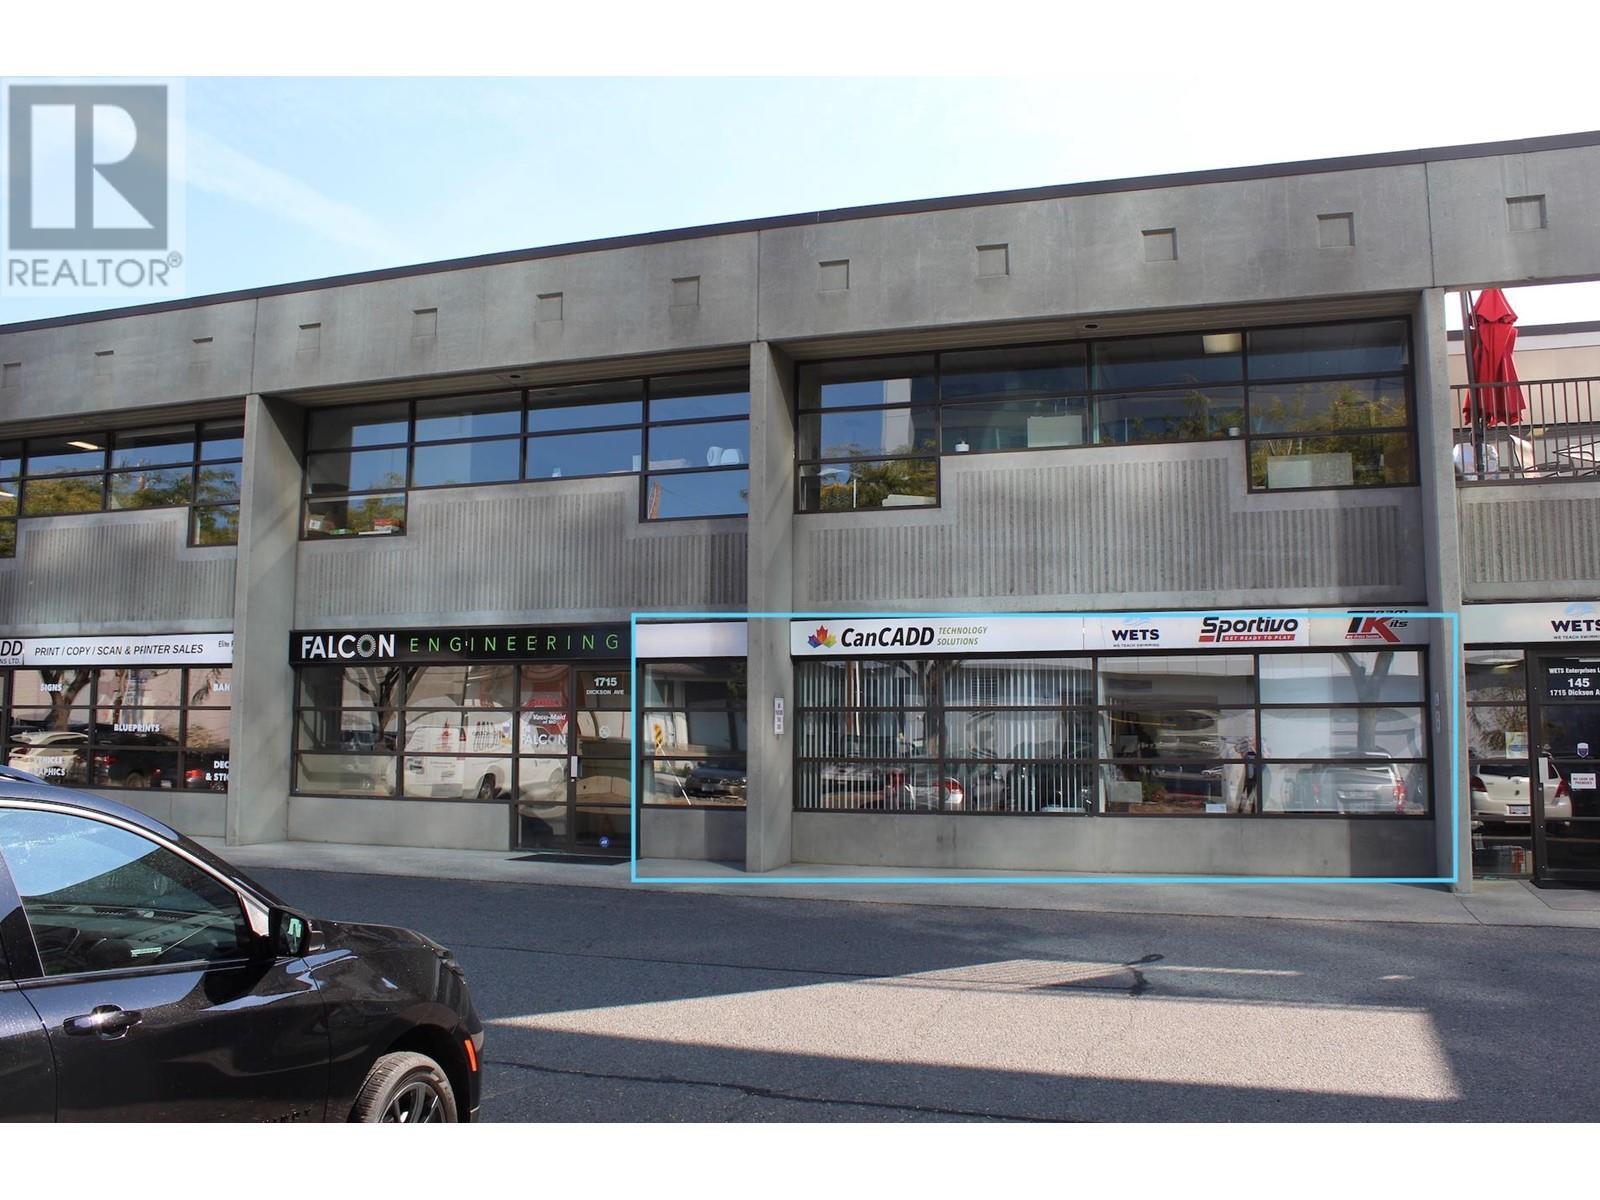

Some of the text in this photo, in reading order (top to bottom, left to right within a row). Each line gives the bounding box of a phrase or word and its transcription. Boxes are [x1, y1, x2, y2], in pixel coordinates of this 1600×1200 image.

[938, 626, 988, 635] TECHNOLOGY
[1200, 616, 1299, 643] Sportivo
[841, 627, 935, 647] CanCADD
[1111, 629, 1160, 641] WETS
[301, 633, 619, 659] FALCON ENGINEERING
[936, 637, 979, 646] SOLUTIONS
[35, 648, 60, 656] PRINT
[67, 647, 90, 655] COPY
[97, 645, 122, 655] SCAN
[124, 645, 131, 655] &
[172, 644, 204, 654] SALES
[40, 683, 62, 691] SIGNS
[594, 678, 617, 687] 1715
[1568, 678, 1590, 687] 145
[114, 724, 160, 732] BLUEPRINTS
[35, 756, 63, 764] EHICLE
[31, 768, 65, 776] APHICS
[205, 773, 212, 781] &
